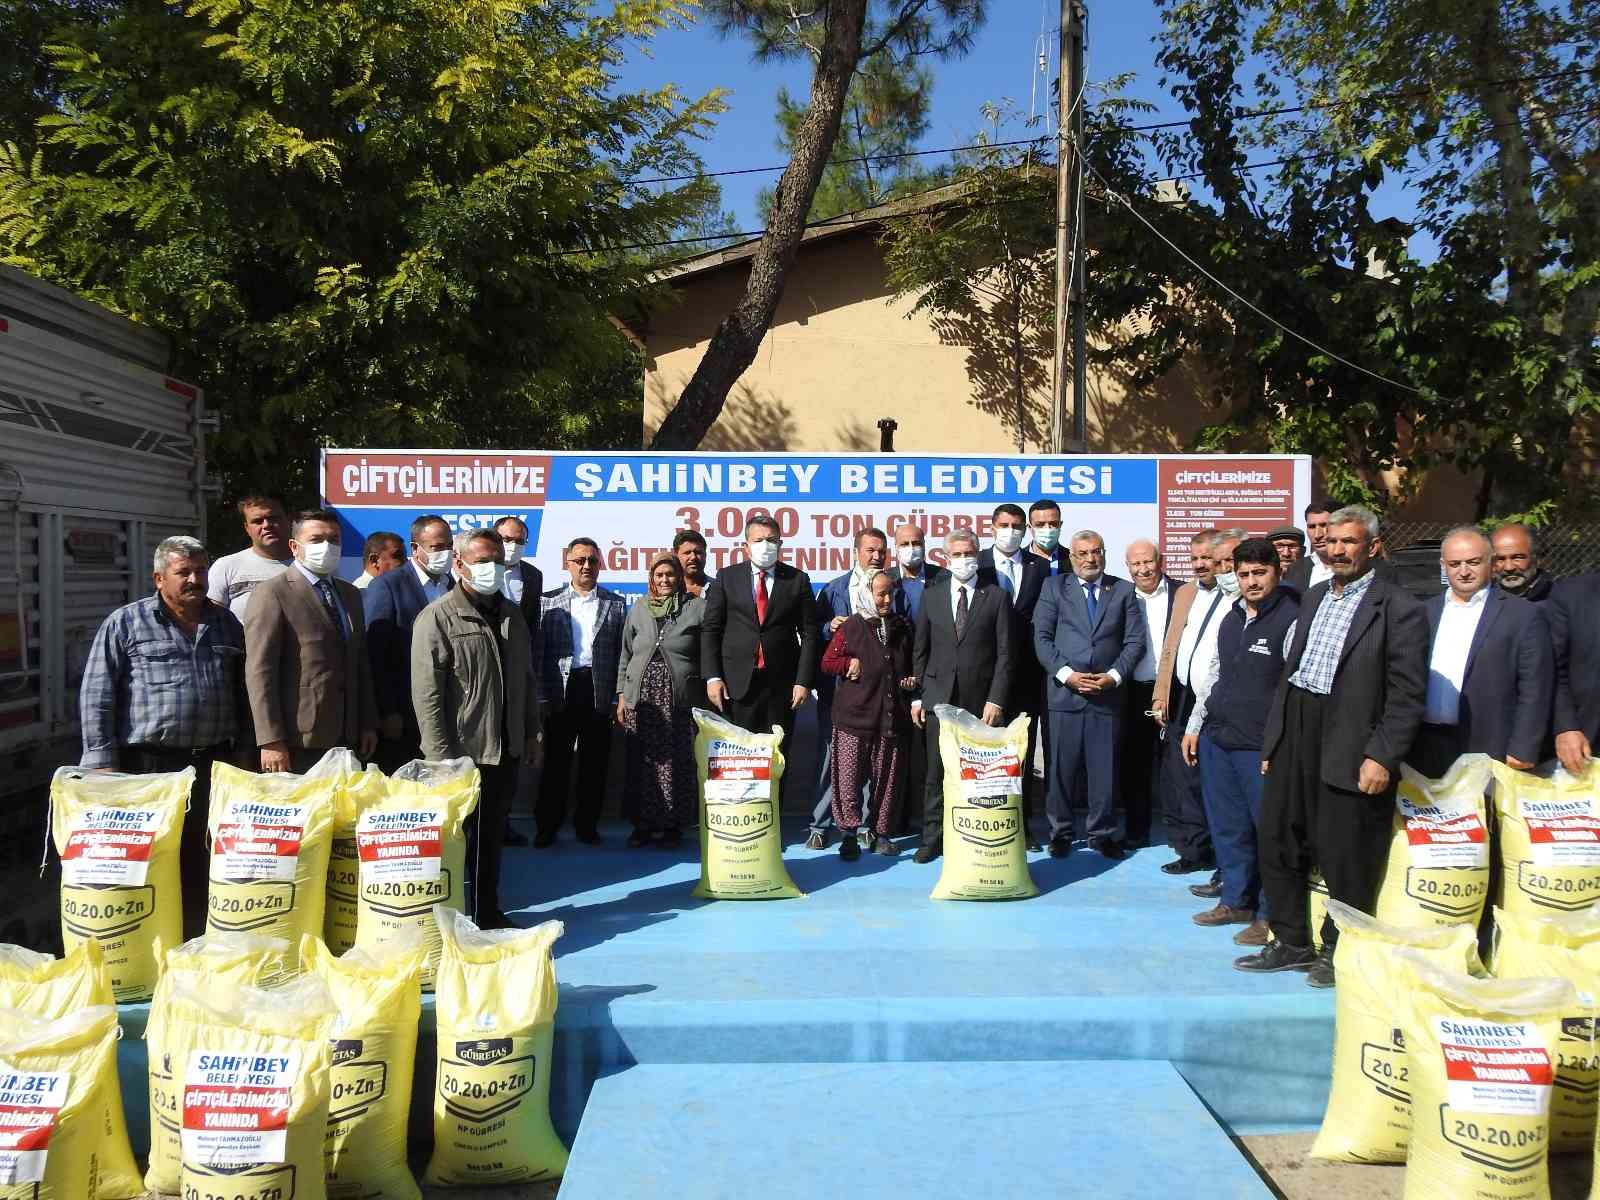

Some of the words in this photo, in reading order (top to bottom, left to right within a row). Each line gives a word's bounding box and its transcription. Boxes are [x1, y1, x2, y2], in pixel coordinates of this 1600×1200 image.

[342, 458, 545, 497] ÇİFTÇİLERİMİZE
[1175, 470, 1272, 485] ÇİFTÇİLERİMİZE
[811, 514, 874, 538] TON
[710, 812, 769, 827] 20.20.0+Zn
[958, 817, 1016, 832] 20.20.0+Zn
[65, 898, 144, 919] 20.20.0+Zn
[444, 1073, 526, 1099] 20.20.0+Zn
[204, 1112, 259, 1128] YANINDA
